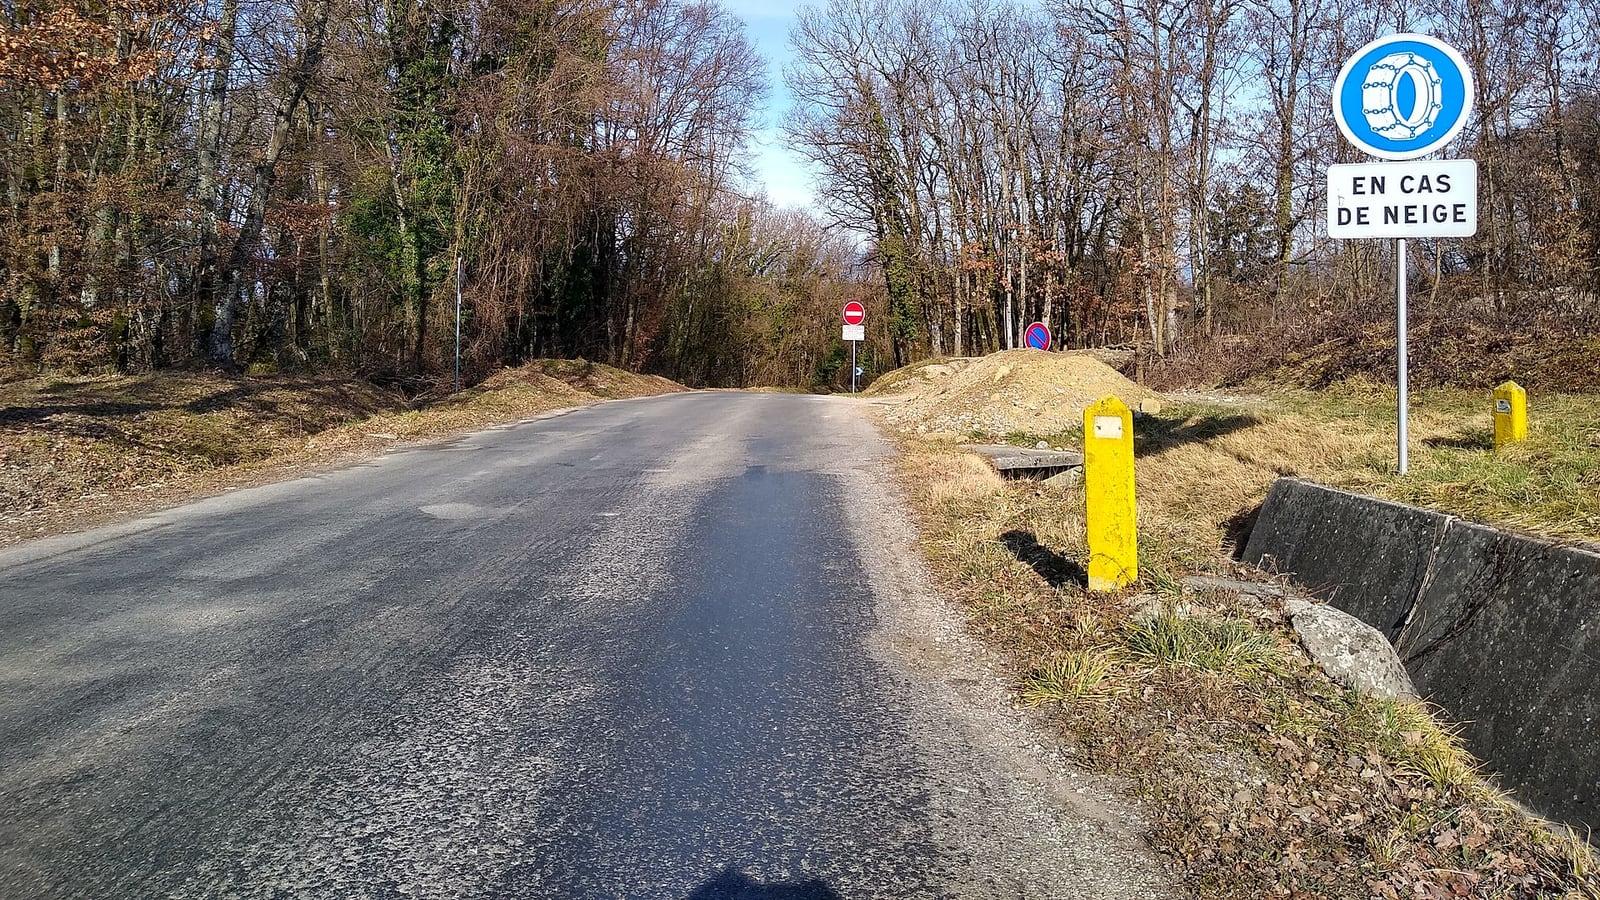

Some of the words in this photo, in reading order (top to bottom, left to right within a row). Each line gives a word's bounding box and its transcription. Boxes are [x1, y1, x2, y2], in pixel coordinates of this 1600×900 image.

[1352, 176, 1386, 195] EN
[1400, 174, 1451, 194] CAS
[1337, 206, 1370, 226] DE
[1383, 203, 1467, 225] NEIGE
